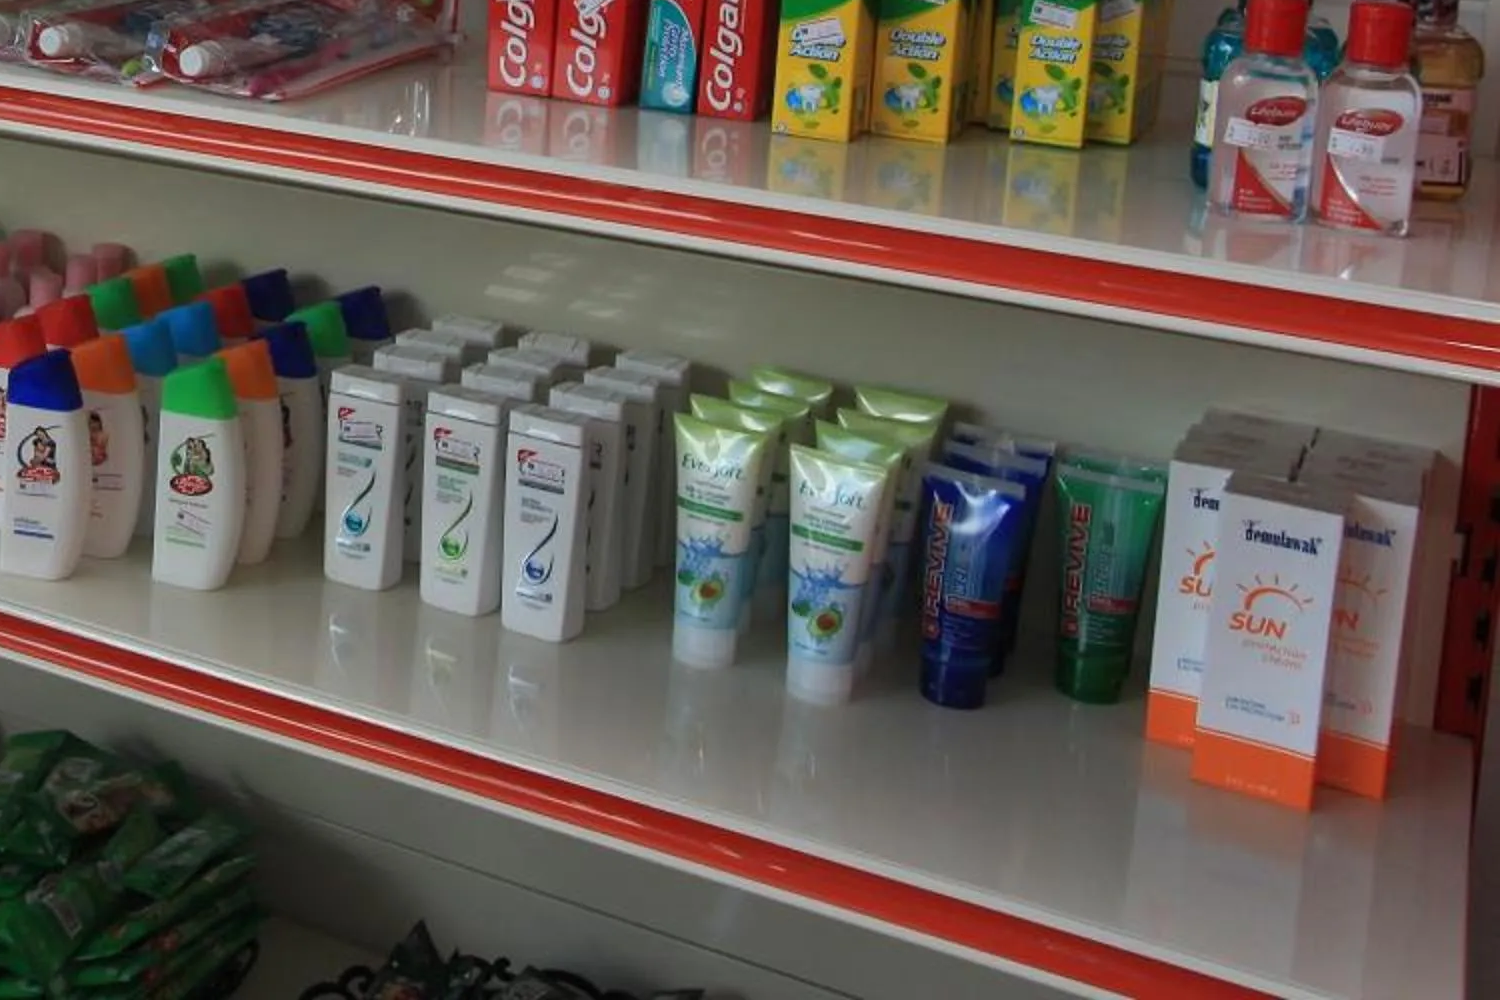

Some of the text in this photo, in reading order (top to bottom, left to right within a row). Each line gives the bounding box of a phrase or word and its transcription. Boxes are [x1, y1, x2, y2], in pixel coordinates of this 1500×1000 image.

[1029, 34, 1082, 51] Double
[1029, 47, 1077, 66] Action
[927, 501, 954, 618] REVIVE
[1065, 503, 1093, 612] REVIVE
[1179, 574, 1212, 598] SU
[1229, 611, 1288, 640] SUN
